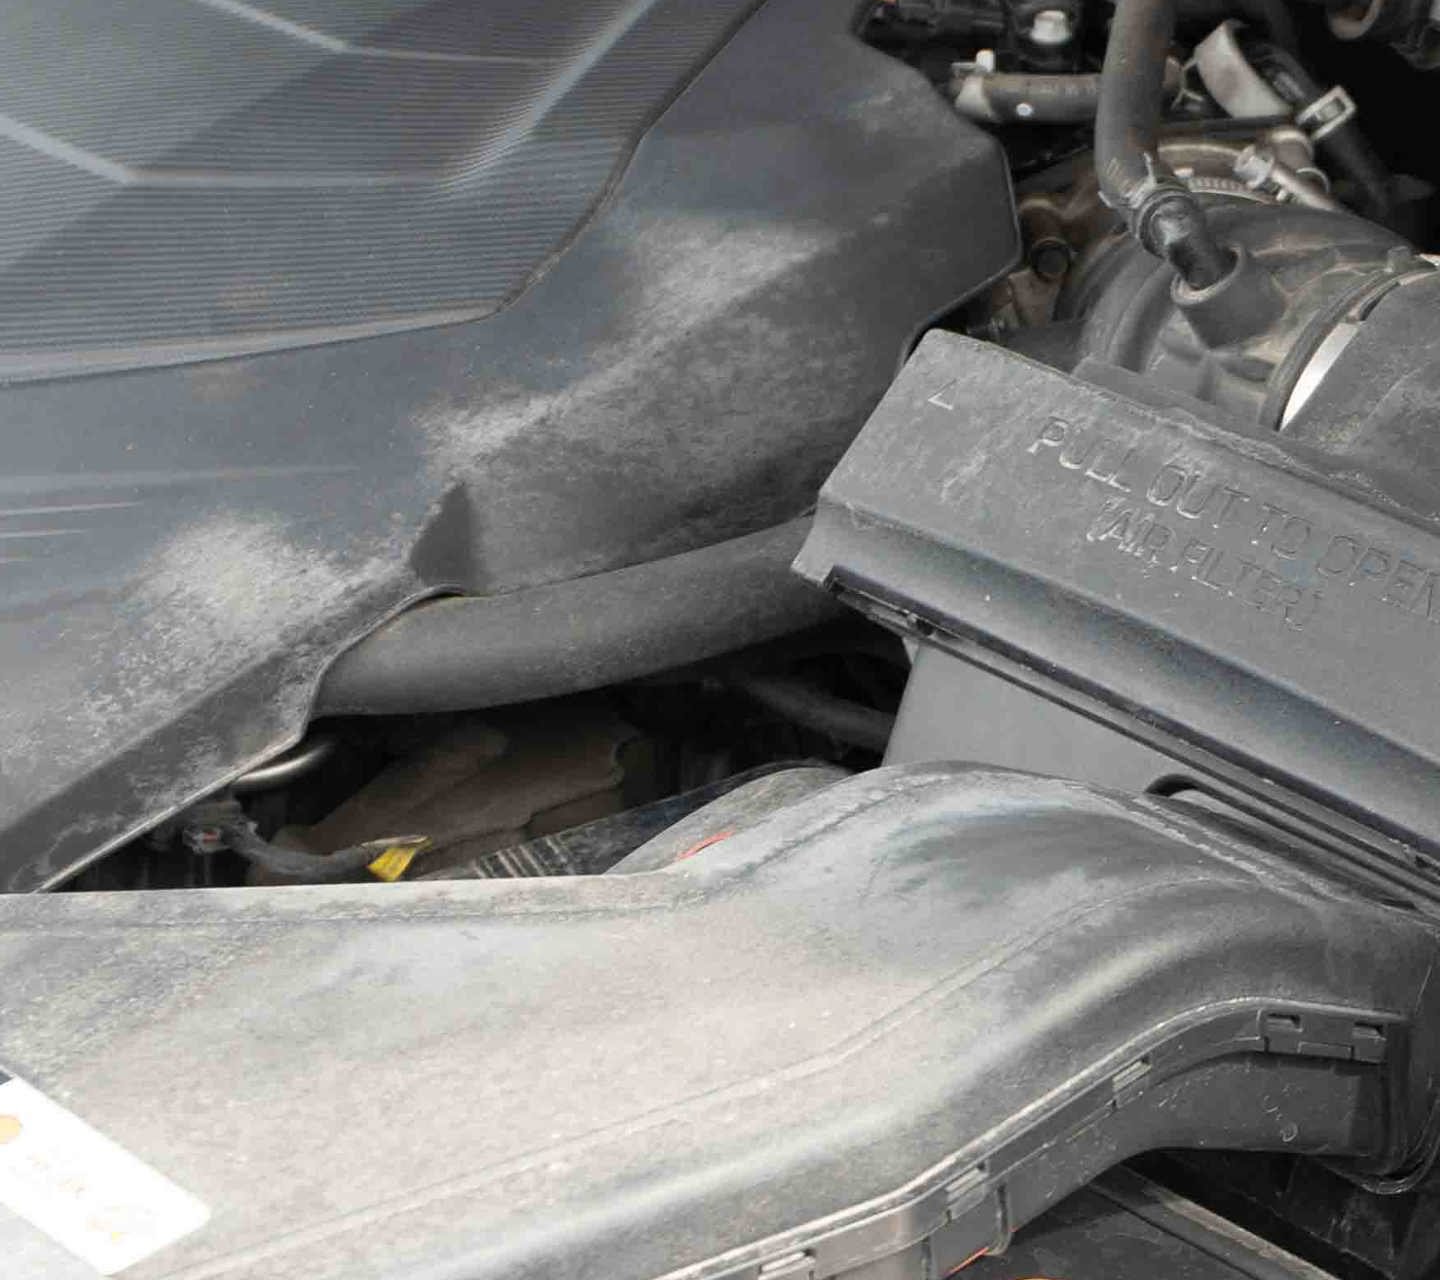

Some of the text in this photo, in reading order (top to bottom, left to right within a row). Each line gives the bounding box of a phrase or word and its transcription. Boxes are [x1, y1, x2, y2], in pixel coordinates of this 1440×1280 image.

[1027, 415, 1133, 495] PULL
[1146, 464, 1251, 522] OUT
[1255, 501, 1311, 561] TO
